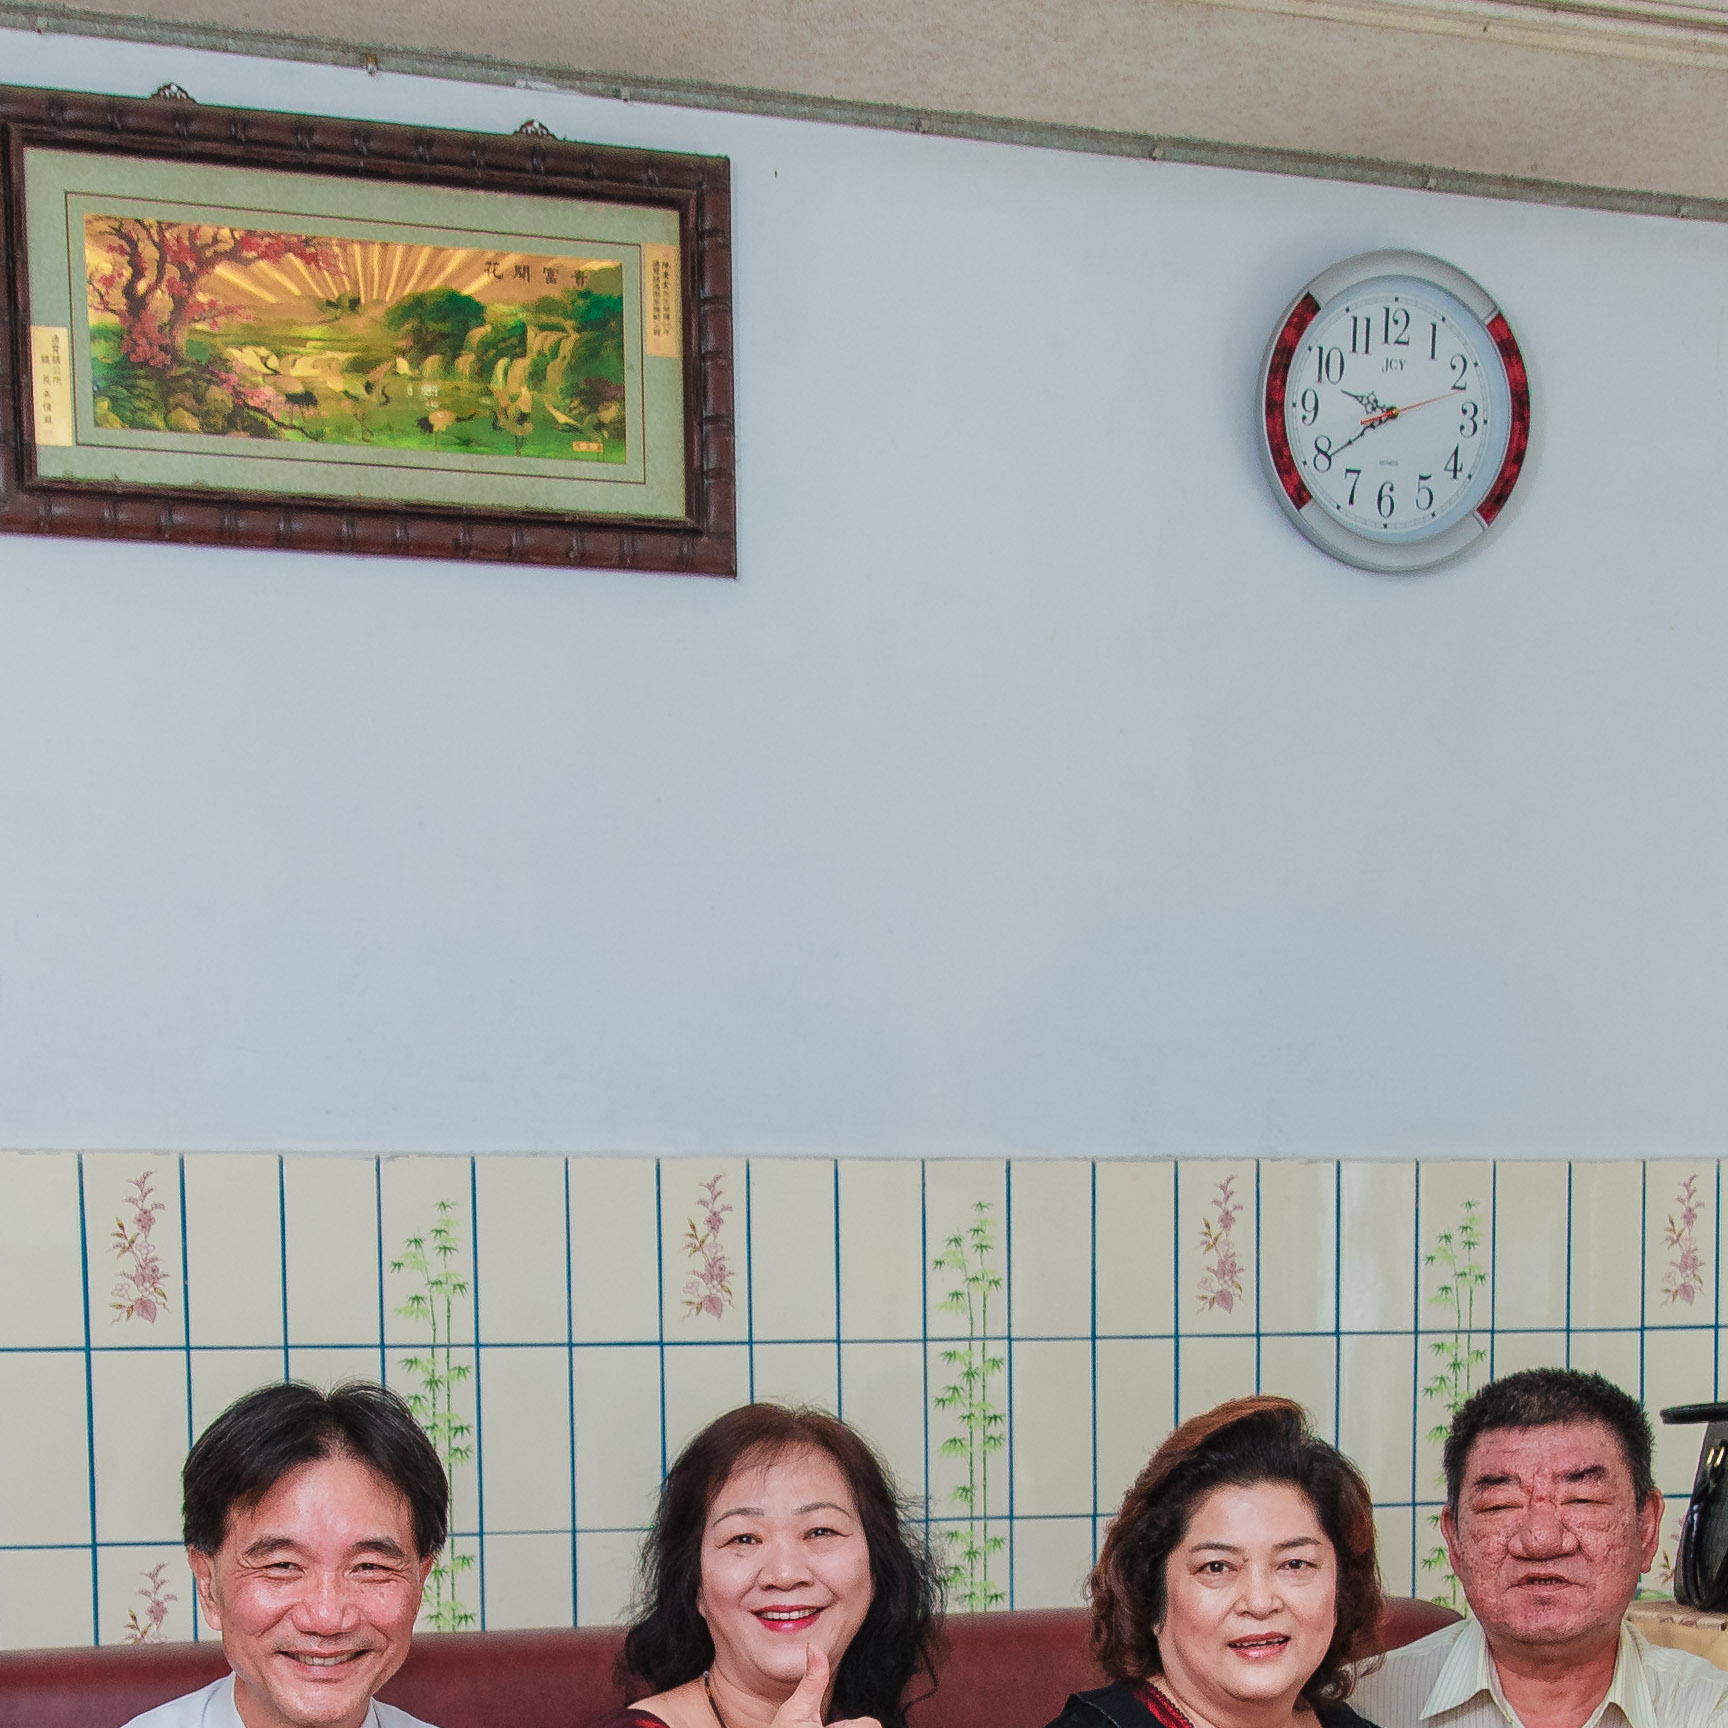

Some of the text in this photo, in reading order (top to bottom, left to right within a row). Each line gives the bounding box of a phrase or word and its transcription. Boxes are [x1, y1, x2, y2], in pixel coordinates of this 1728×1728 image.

[1350, 315, 1371, 355] 11
[1381, 306, 1410, 346] 12
[1429, 322, 1438, 360] 1
[1316, 345, 1345, 385] 10
[1449, 354, 1468, 391] 2
[1300, 388, 1319, 426] 9
[1459, 401, 1479, 438] 3
[1312, 435, 1333, 473] 8
[1443, 443, 1464, 480] 4
[1343, 468, 1362, 506] 7
[1377, 481, 1395, 519] 6
[1415, 473, 1434, 511] 5
